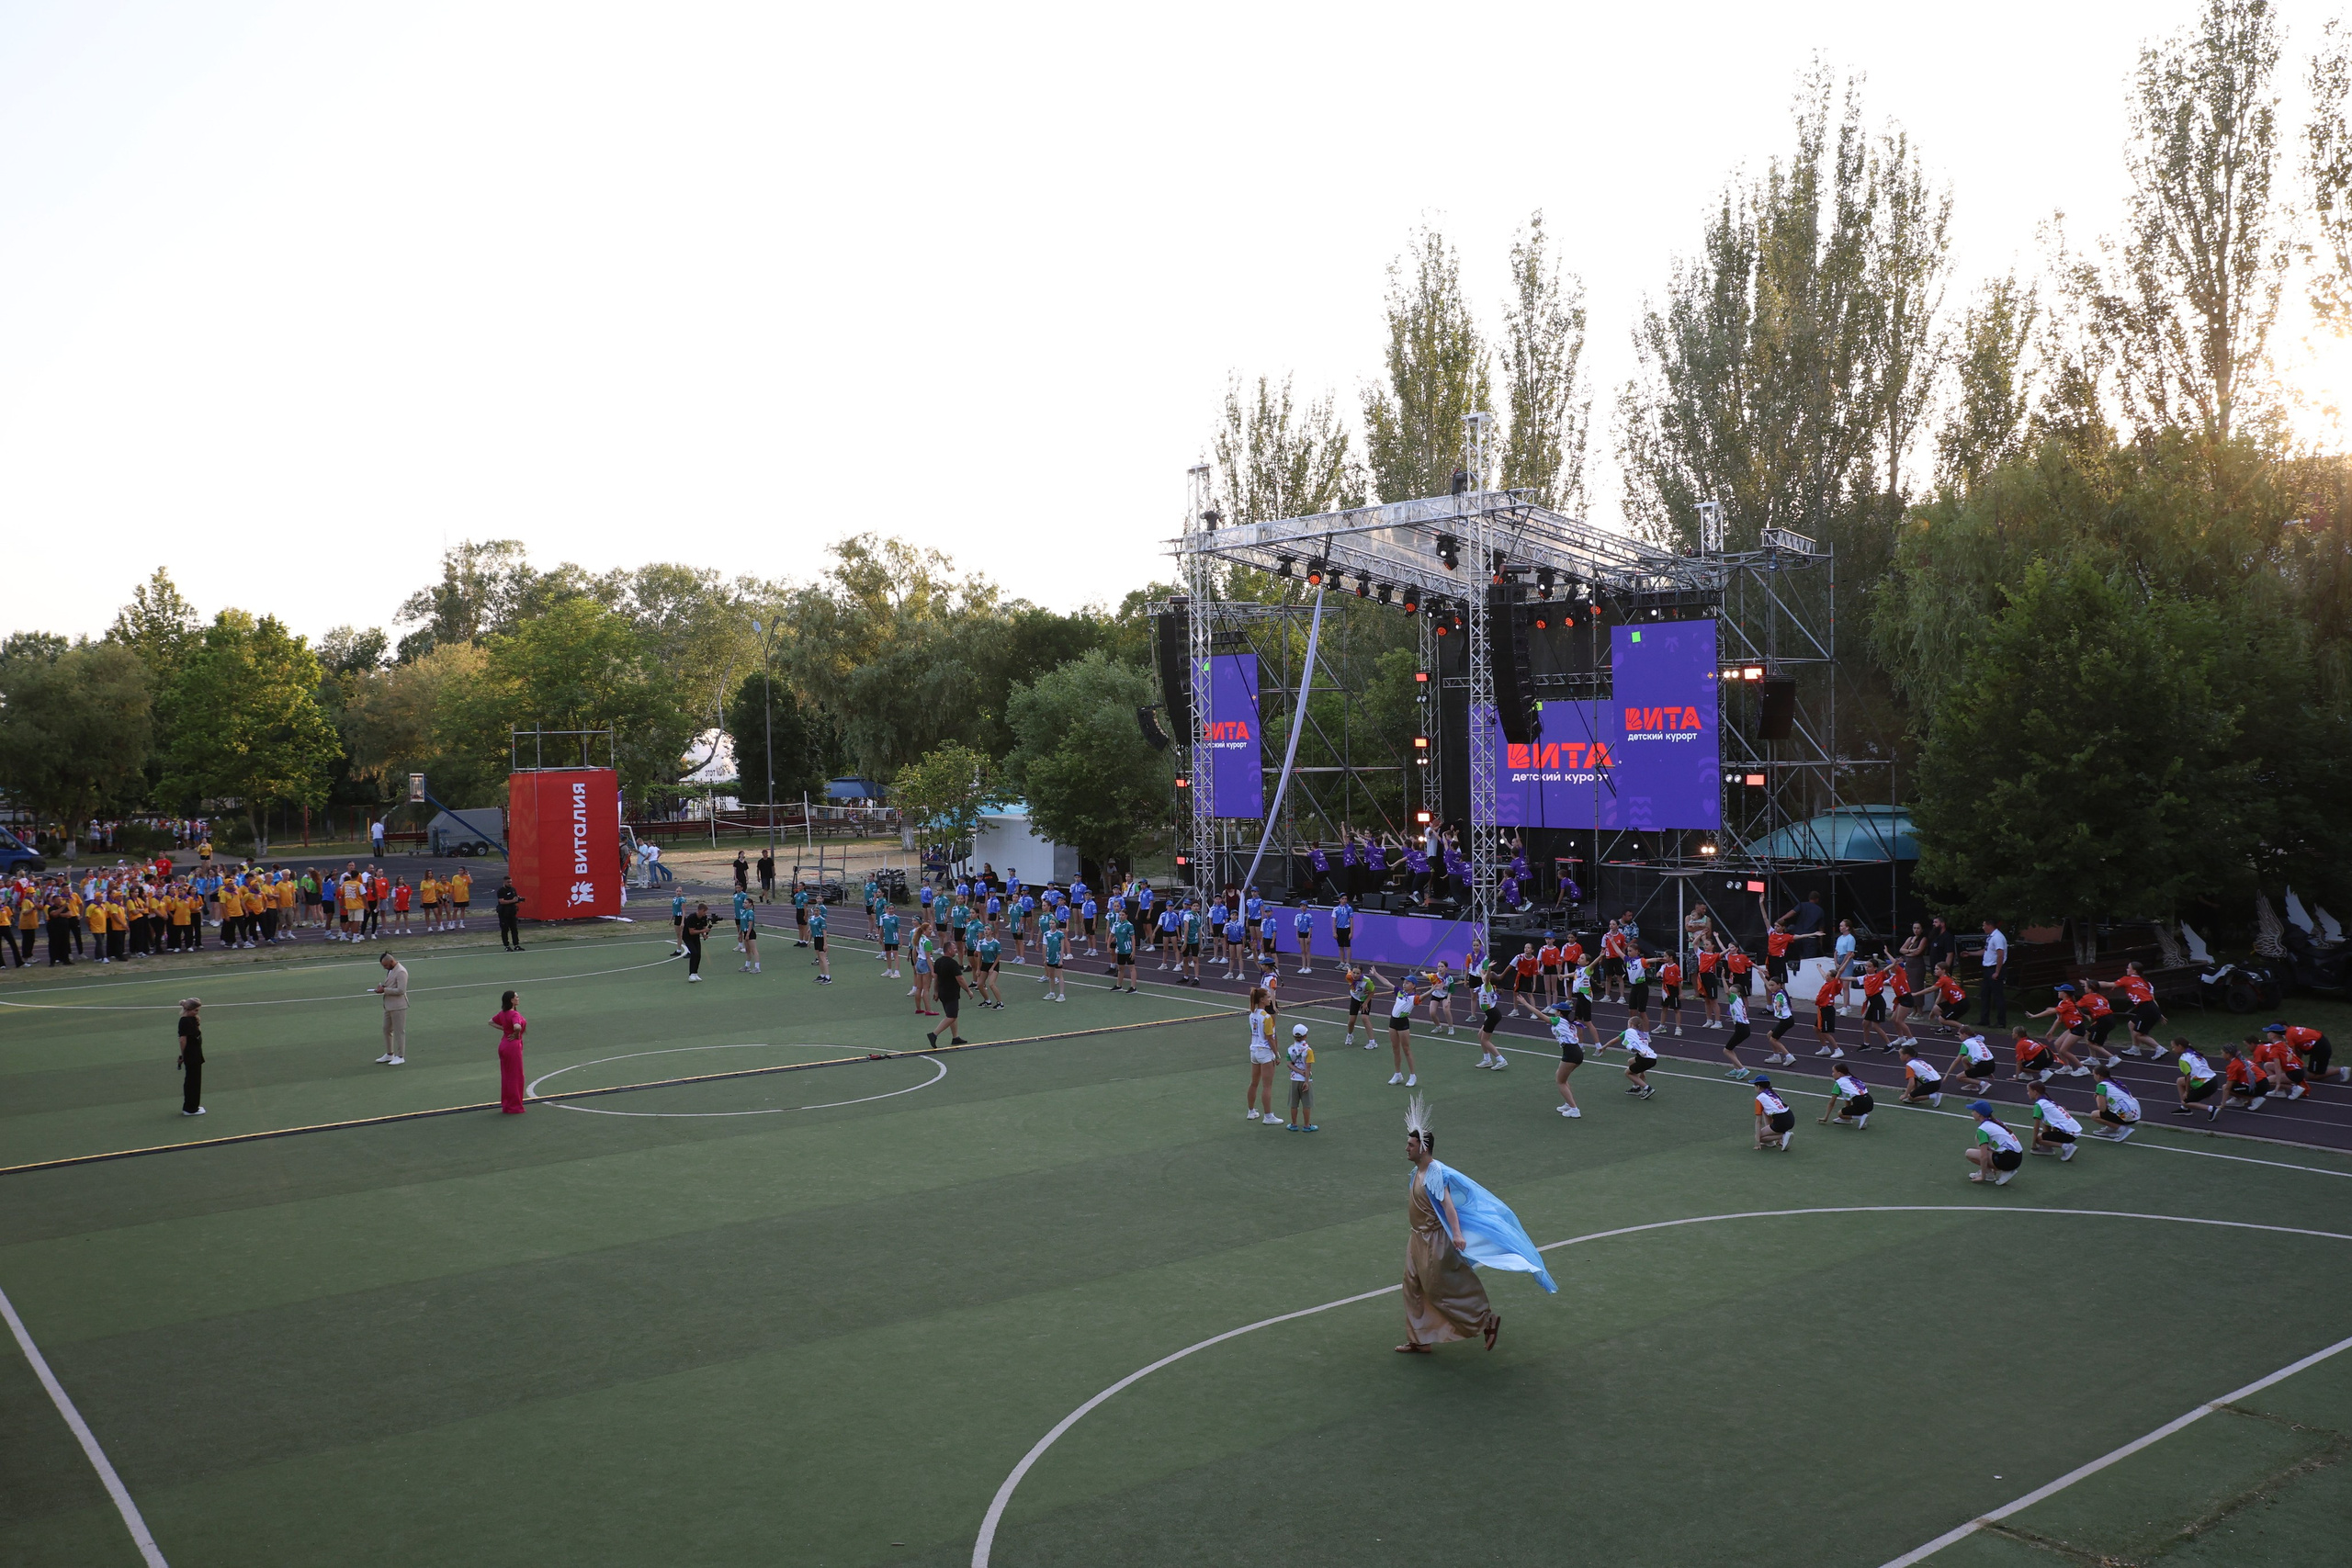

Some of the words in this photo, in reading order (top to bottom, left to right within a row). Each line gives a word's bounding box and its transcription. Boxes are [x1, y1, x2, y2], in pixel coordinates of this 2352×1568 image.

[1625, 706, 1702, 730] ВИТА
[1627, 731, 1663, 741] детский
[1666, 732, 1698, 742] курорт
[1226, 741, 1248, 750] курорт
[1508, 742, 1614, 769] ВИТА
[1511, 772, 1561, 783] детский
